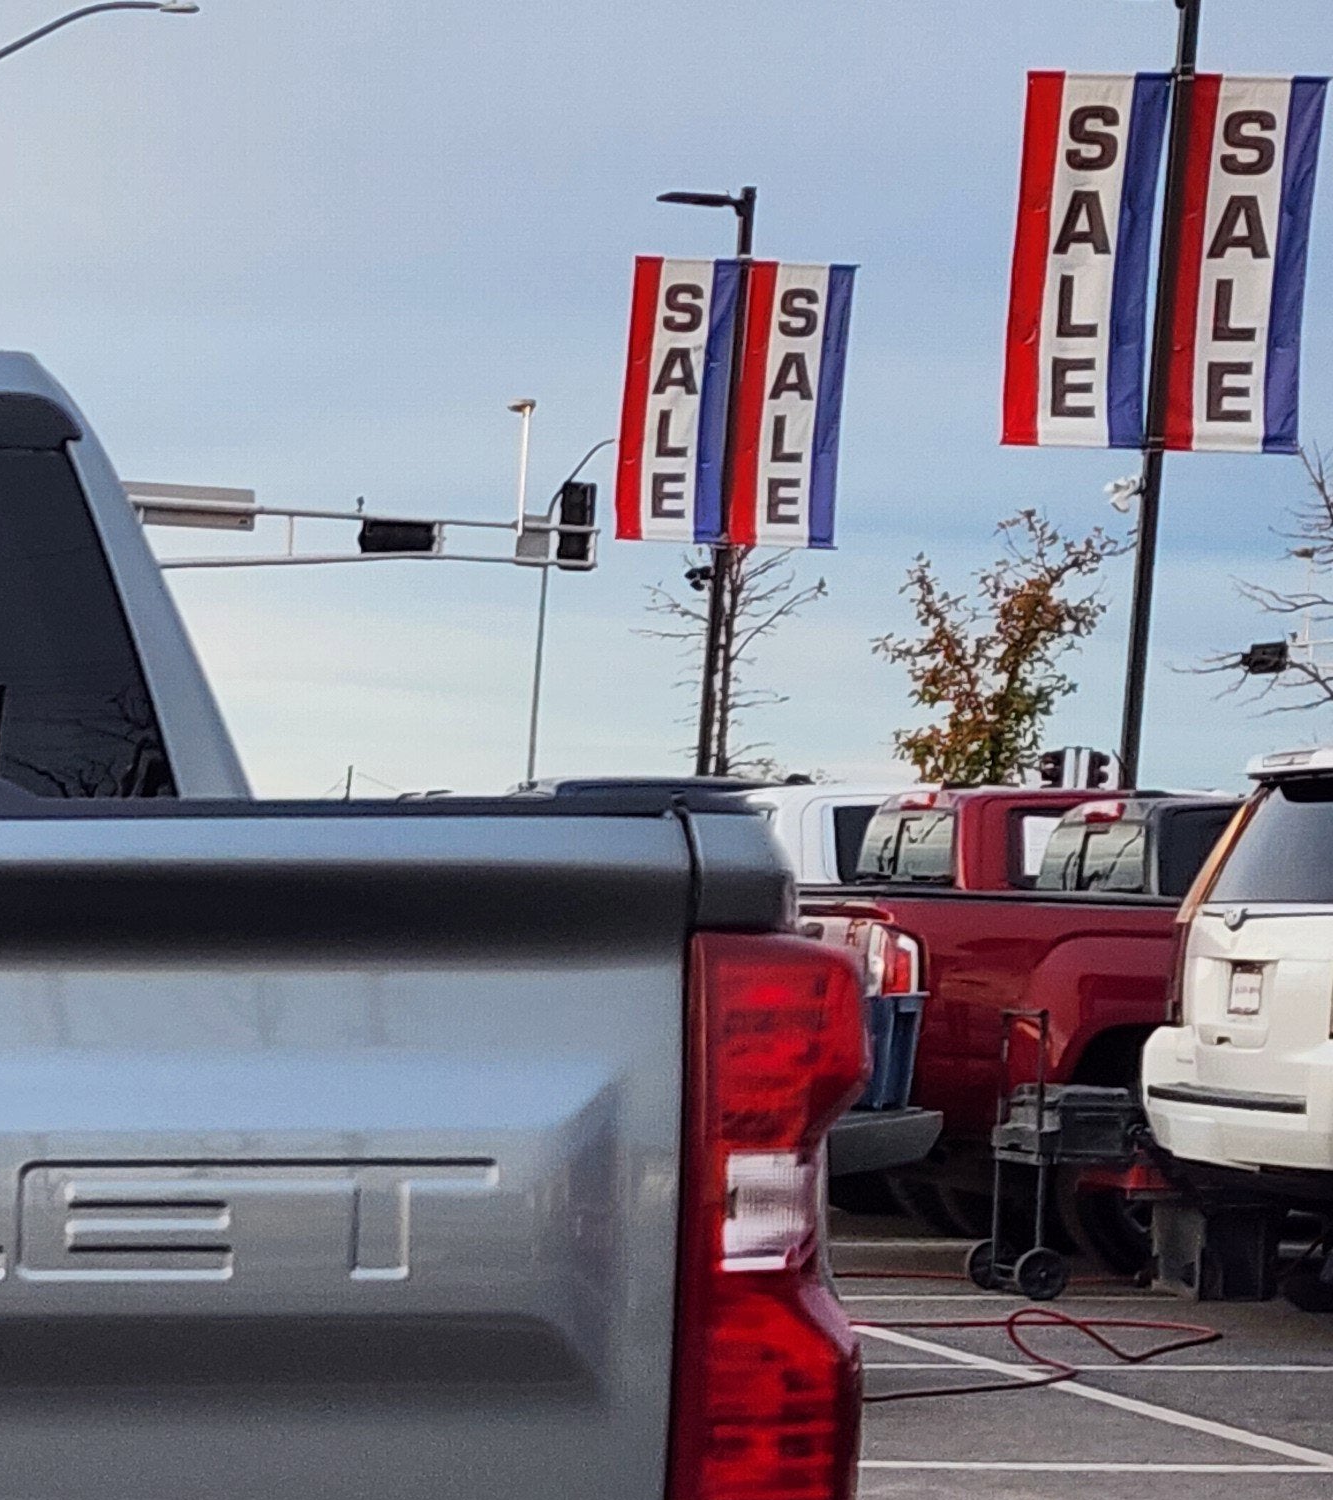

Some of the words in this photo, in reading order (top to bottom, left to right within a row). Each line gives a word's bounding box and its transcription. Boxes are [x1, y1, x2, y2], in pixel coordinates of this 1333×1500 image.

[1049, 104, 1121, 419] SALE
[1205, 110, 1277, 423] SALE
[650, 282, 704, 520] SALE
[765, 287, 821, 525] SALE
